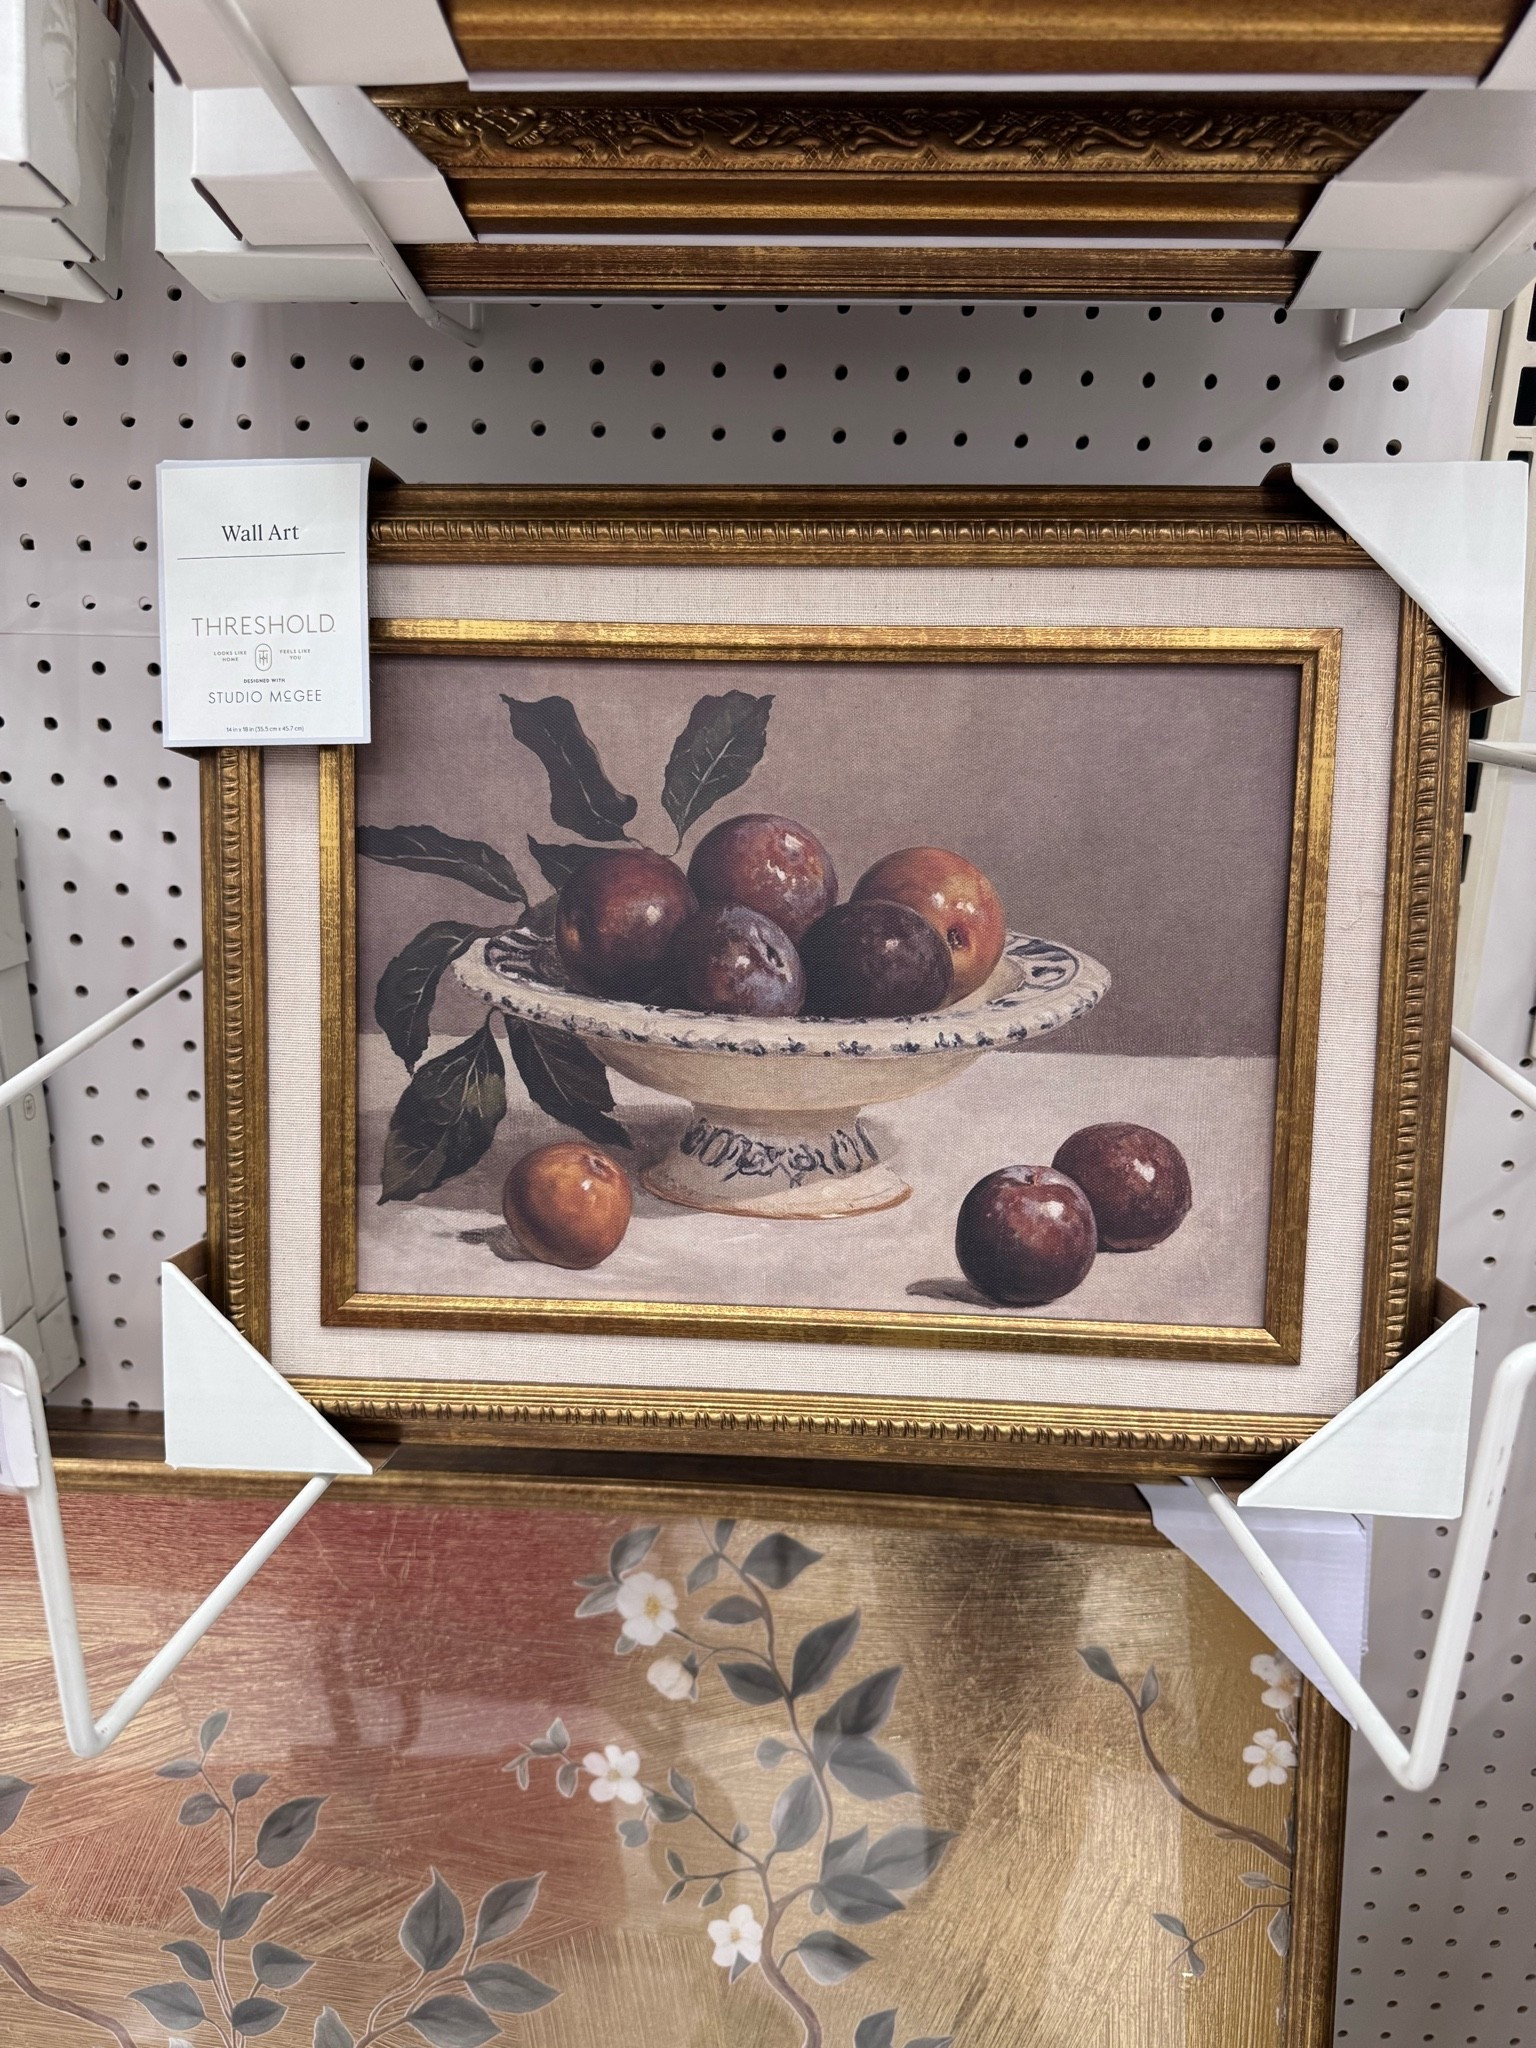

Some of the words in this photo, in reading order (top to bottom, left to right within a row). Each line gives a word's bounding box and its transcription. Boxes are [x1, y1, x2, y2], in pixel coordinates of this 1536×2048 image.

[222, 524, 262, 542] Wall
[268, 523, 300, 541] Art
[191, 613, 336, 636] THRESHOLD
[208, 690, 263, 704] STUDIO
